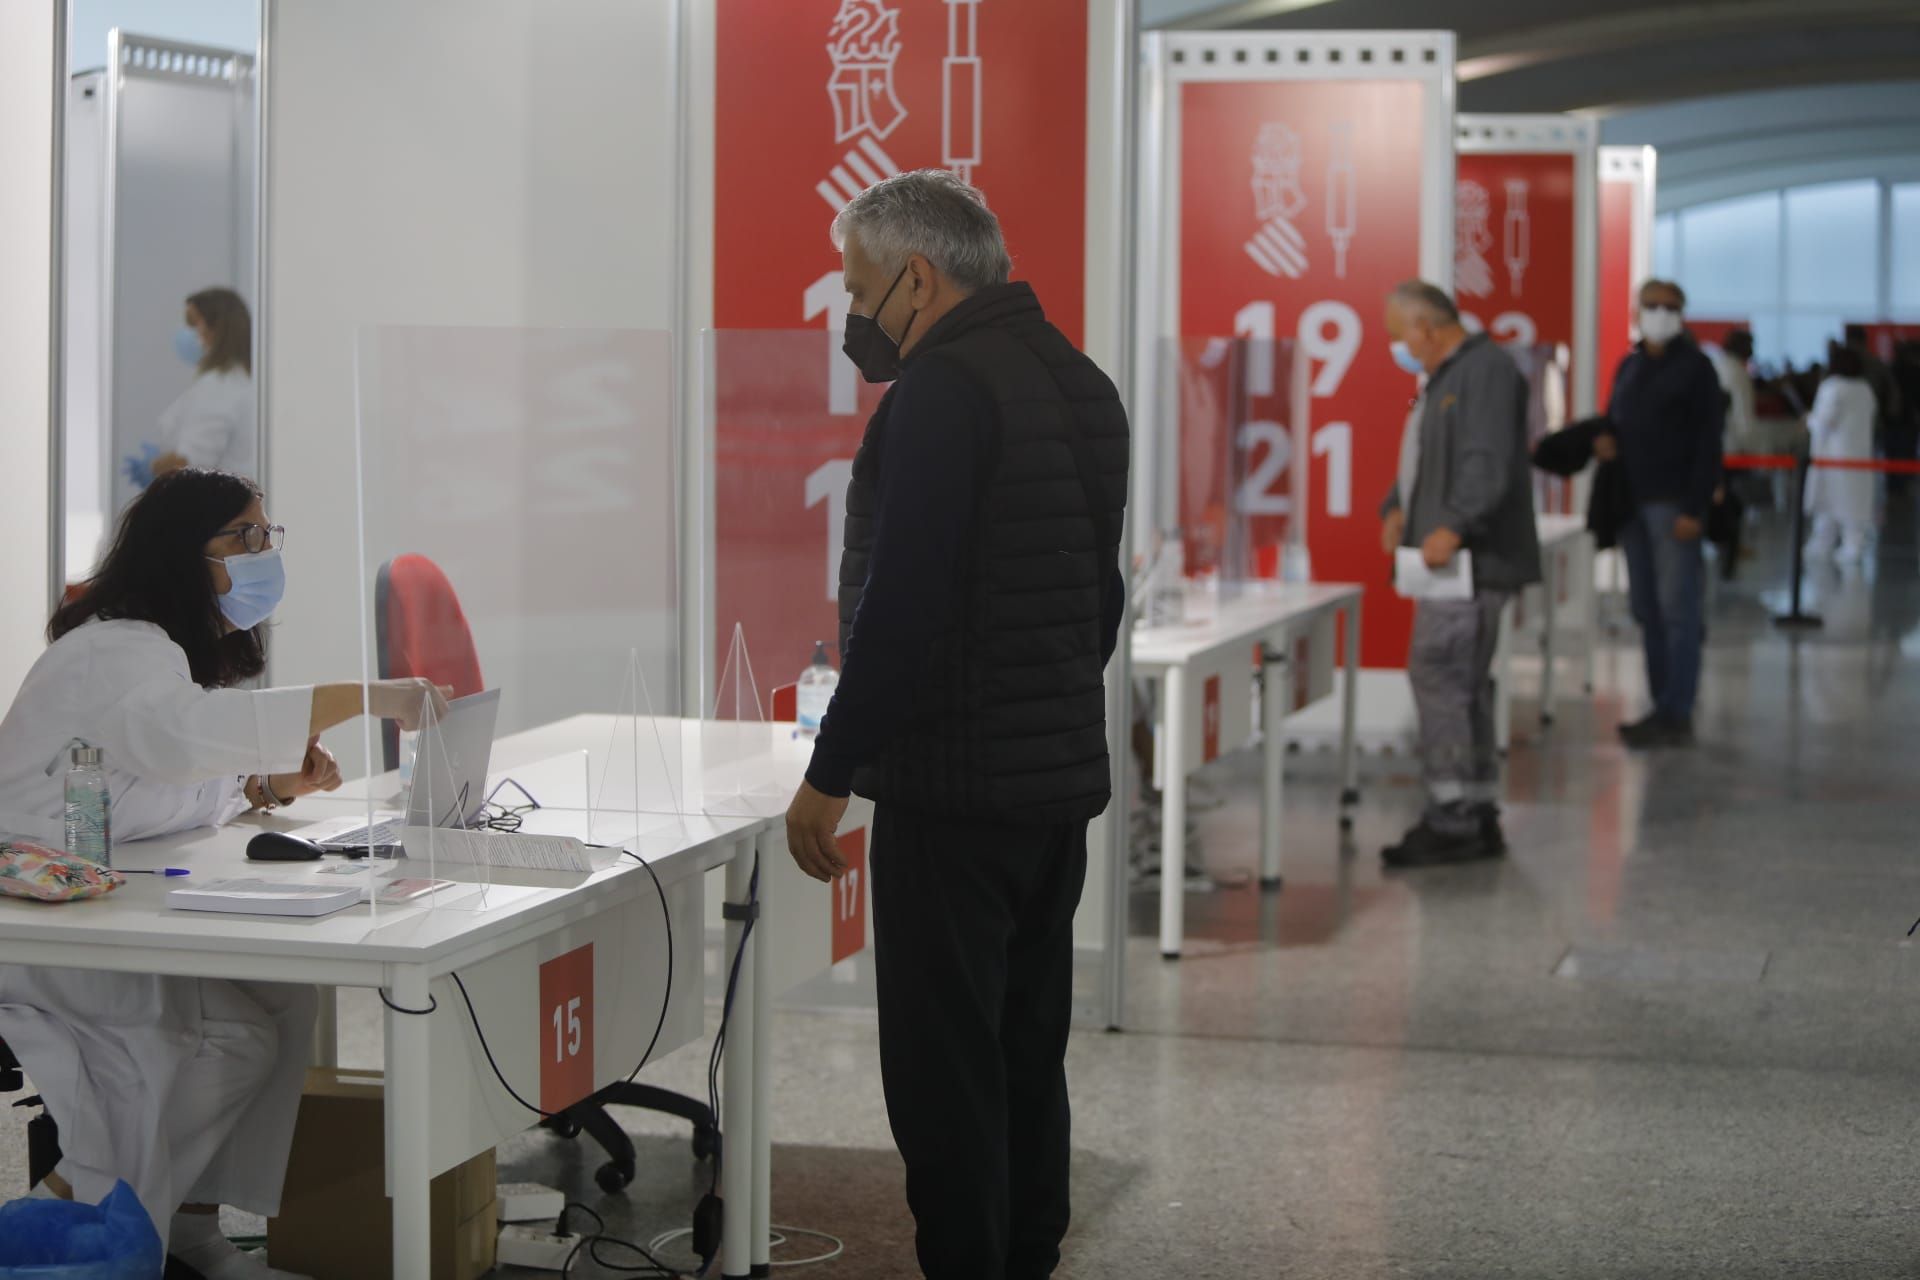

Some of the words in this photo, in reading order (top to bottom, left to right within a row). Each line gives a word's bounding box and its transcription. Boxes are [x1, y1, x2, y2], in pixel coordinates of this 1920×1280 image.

[803, 270, 858, 416] 1
[1234, 299, 1363, 398] 19
[1235, 420, 1354, 518] 21
[839, 867, 859, 922] 17
[553, 996, 581, 1064] 15
